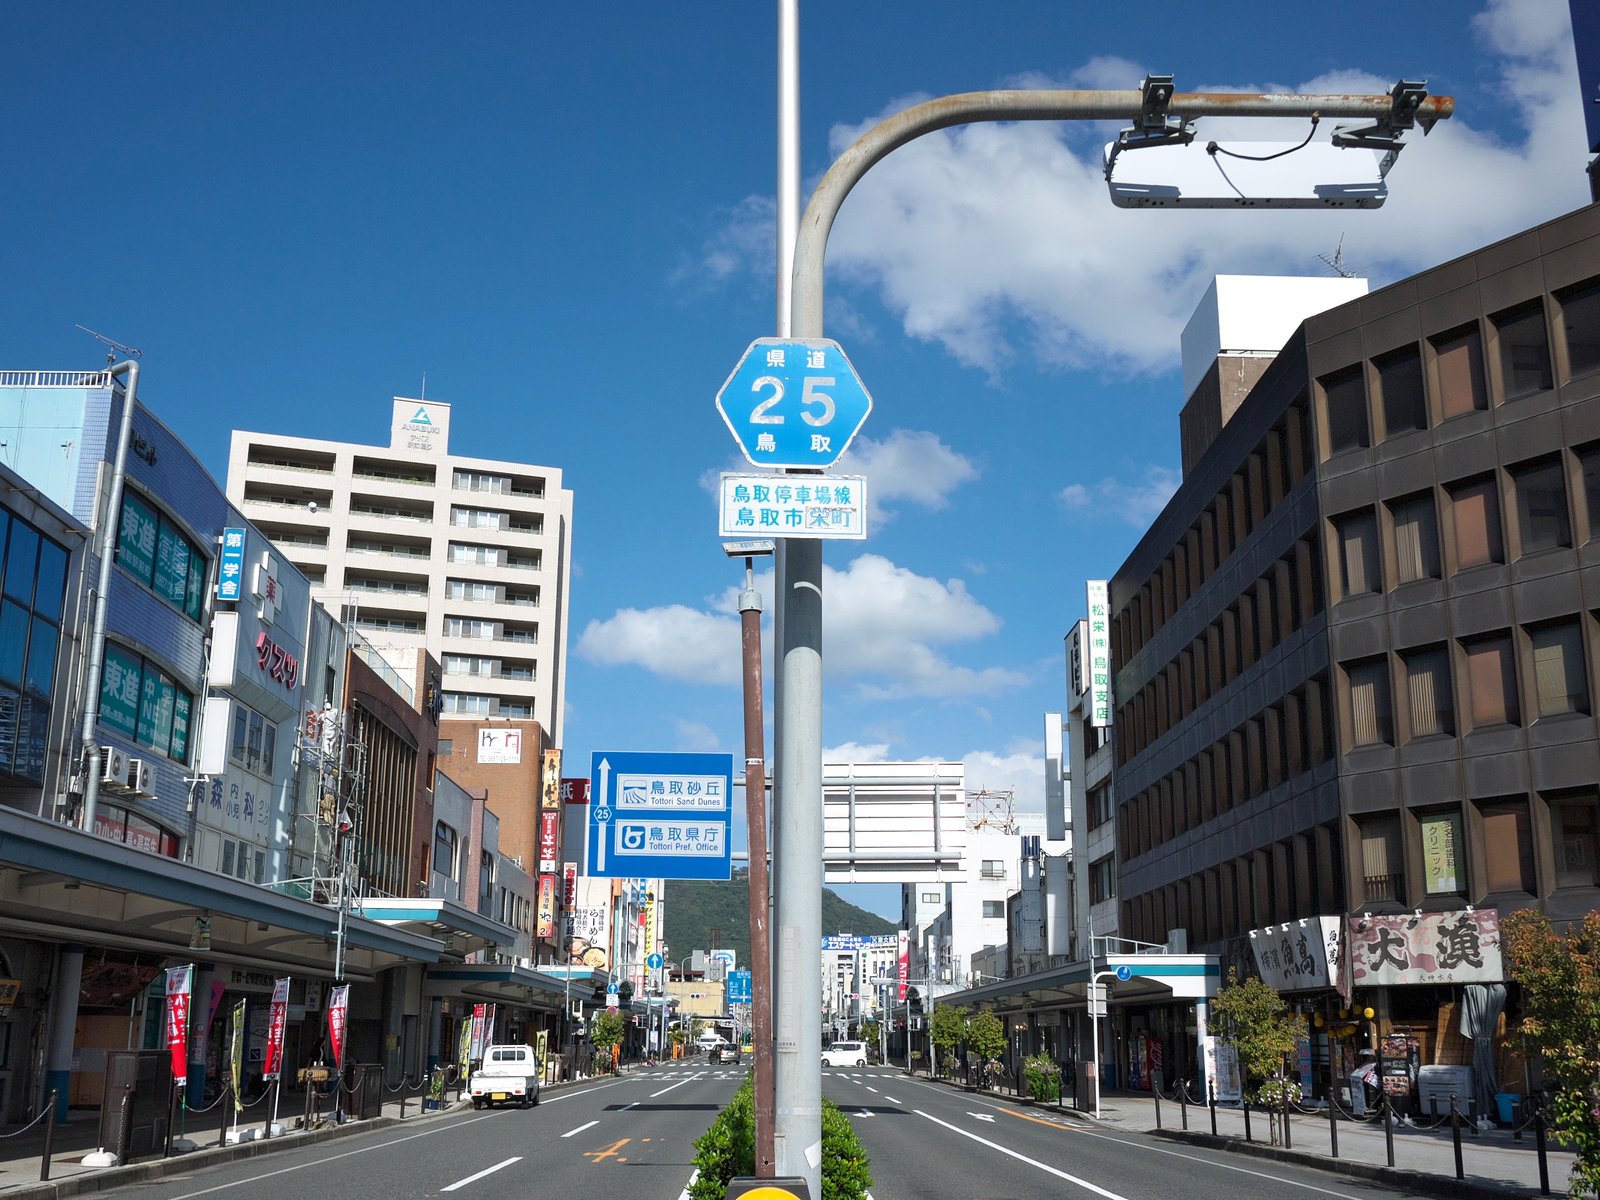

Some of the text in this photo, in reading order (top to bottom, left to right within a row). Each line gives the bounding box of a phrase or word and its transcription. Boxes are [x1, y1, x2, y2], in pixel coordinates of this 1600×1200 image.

[766, 349, 826, 369] 県道
[750, 375, 836, 427] 25
[756, 432, 832, 453] 鳥取
[732, 484, 852, 504] 鳥取停車場線
[735, 507, 852, 528] 鳥取市栄町
[221, 532, 243, 596] 第一学舎
[265, 575, 277, 605] 薬
[650, 780, 720, 796] 鳥取砂丘
[243, 791, 255, 824] 科
[651, 796, 721, 806] Tottori Sand Dunes
[597, 809, 609, 819] 25
[648, 827, 719, 842] 鳥取県庁
[649, 842, 719, 851] Tottori Pref. Office
[1428, 826, 1441, 876] クリニック
[540, 927, 550, 936] 2F
[589, 909, 599, 945] らーめん
